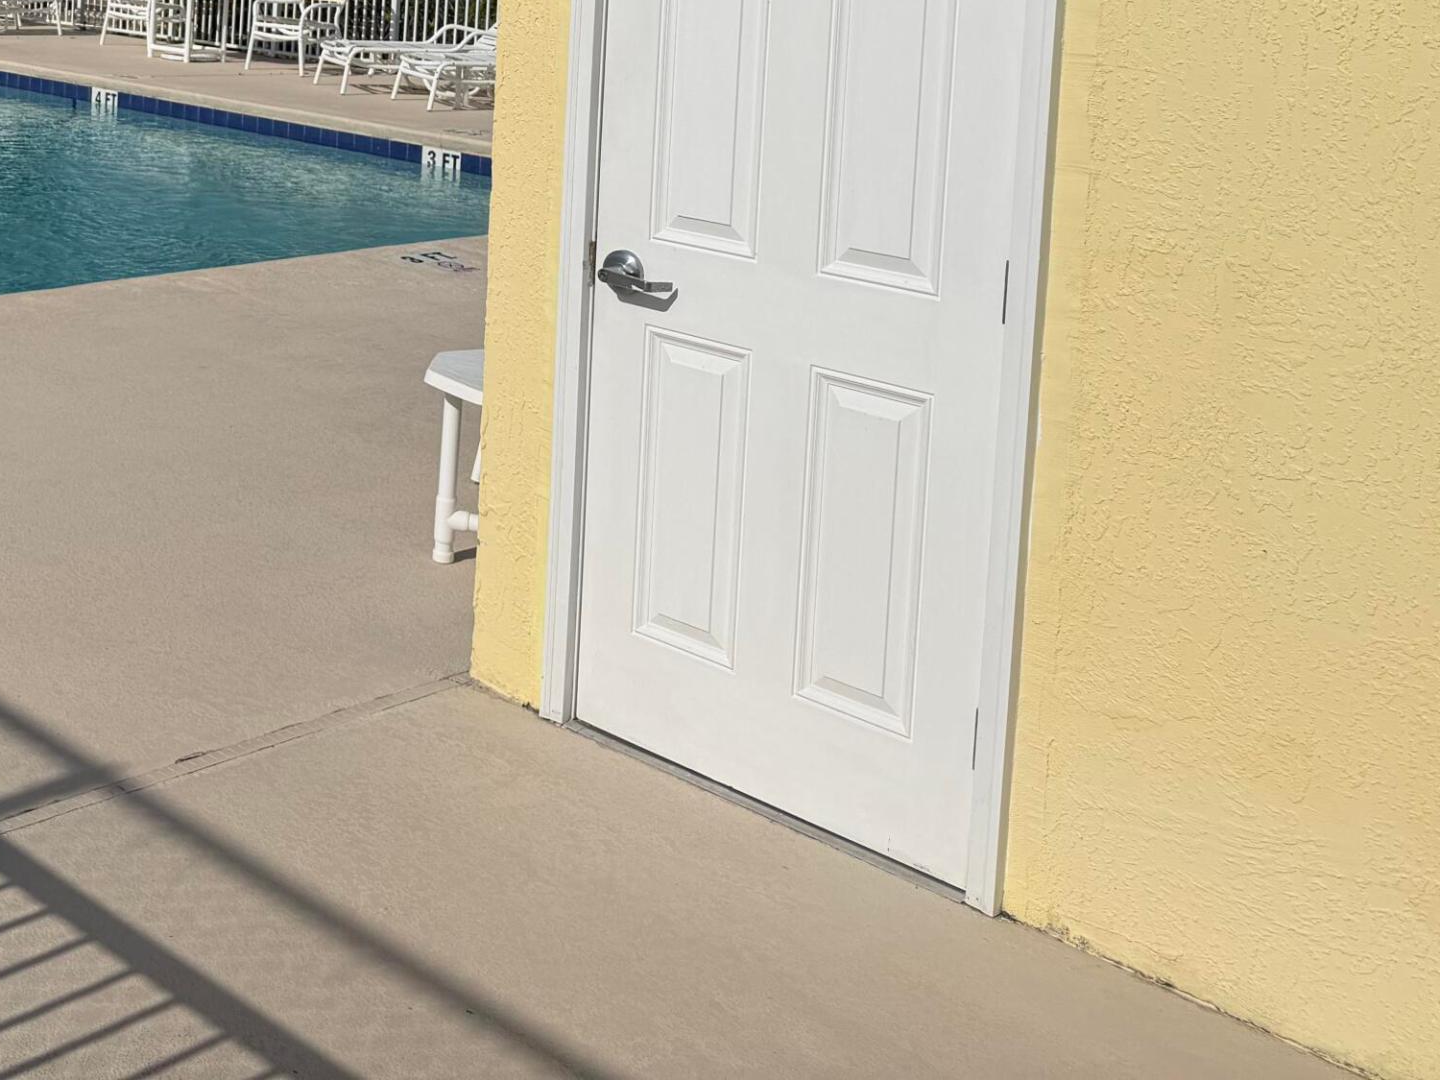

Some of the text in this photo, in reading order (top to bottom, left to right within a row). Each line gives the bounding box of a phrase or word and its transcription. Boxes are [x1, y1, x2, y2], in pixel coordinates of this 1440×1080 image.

[95, 91, 117, 111] 4 FT
[427, 150, 460, 172] 3 FT
